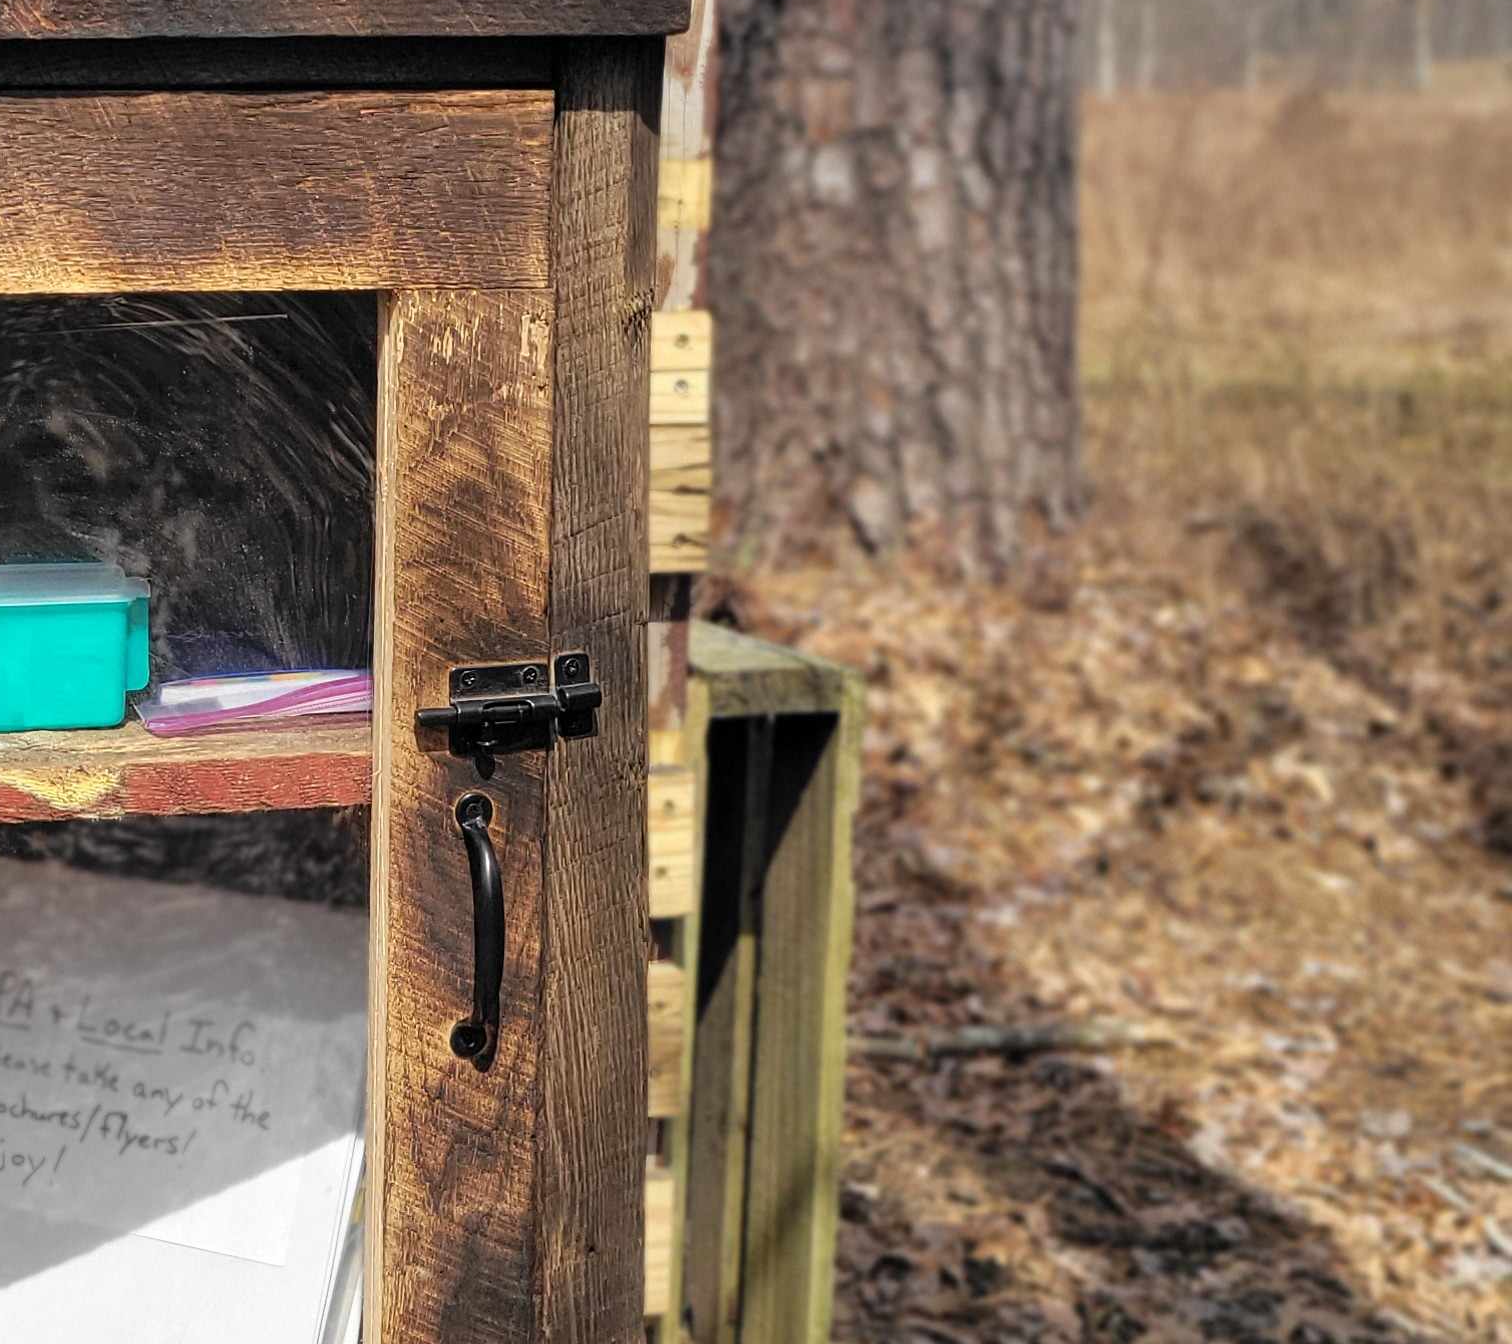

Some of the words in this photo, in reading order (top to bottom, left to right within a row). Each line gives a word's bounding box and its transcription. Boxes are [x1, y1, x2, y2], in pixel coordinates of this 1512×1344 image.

[76, 994, 172, 1046] Local
[63, 1053, 119, 1093] take
[132, 1080, 183, 1117] any
[191, 1078, 230, 1112] of
[229, 1087, 271, 1131] the
